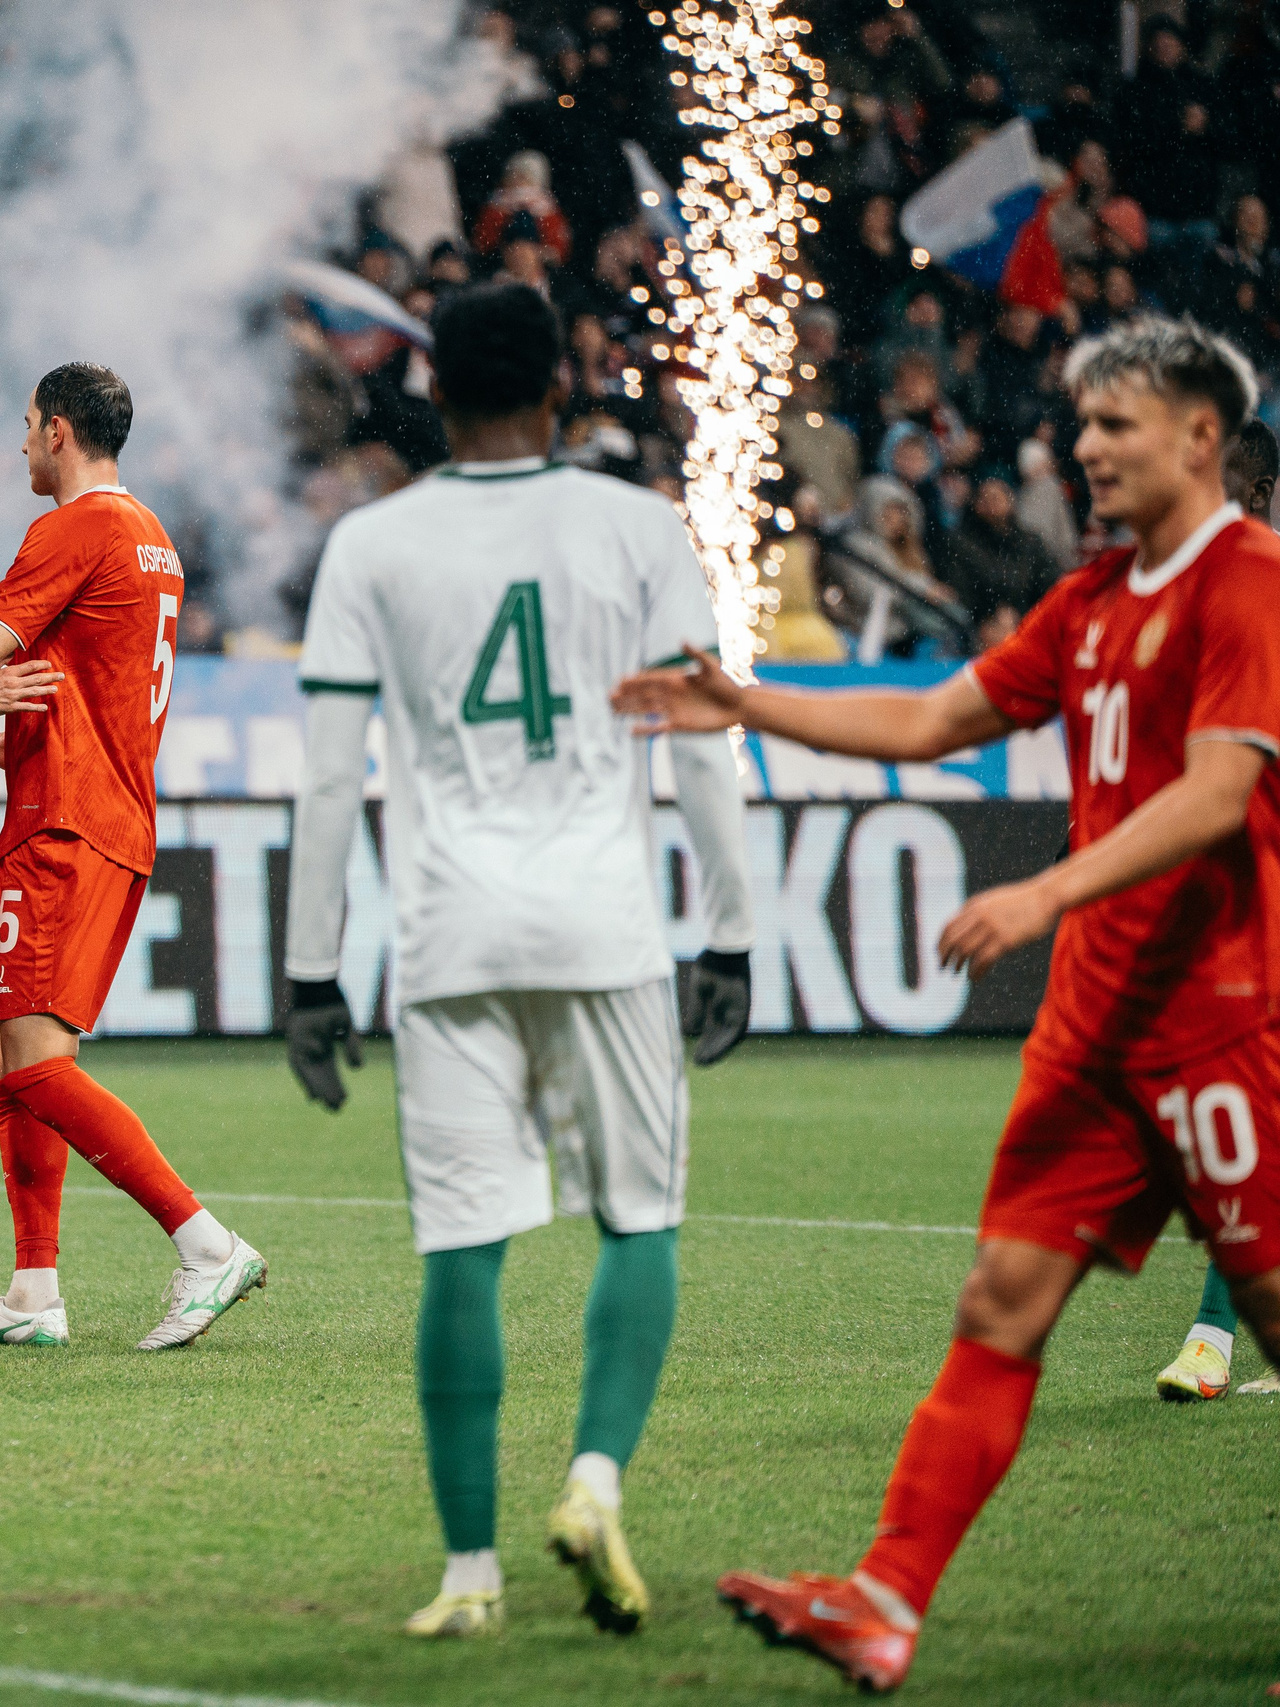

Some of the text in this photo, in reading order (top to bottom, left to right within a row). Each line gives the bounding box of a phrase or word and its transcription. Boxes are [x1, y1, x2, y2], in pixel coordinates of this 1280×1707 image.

[150, 592, 178, 725] 5
[462, 580, 572, 762] 4
[1082, 679, 1129, 787] 10
[1156, 1082, 1259, 1186] 10
